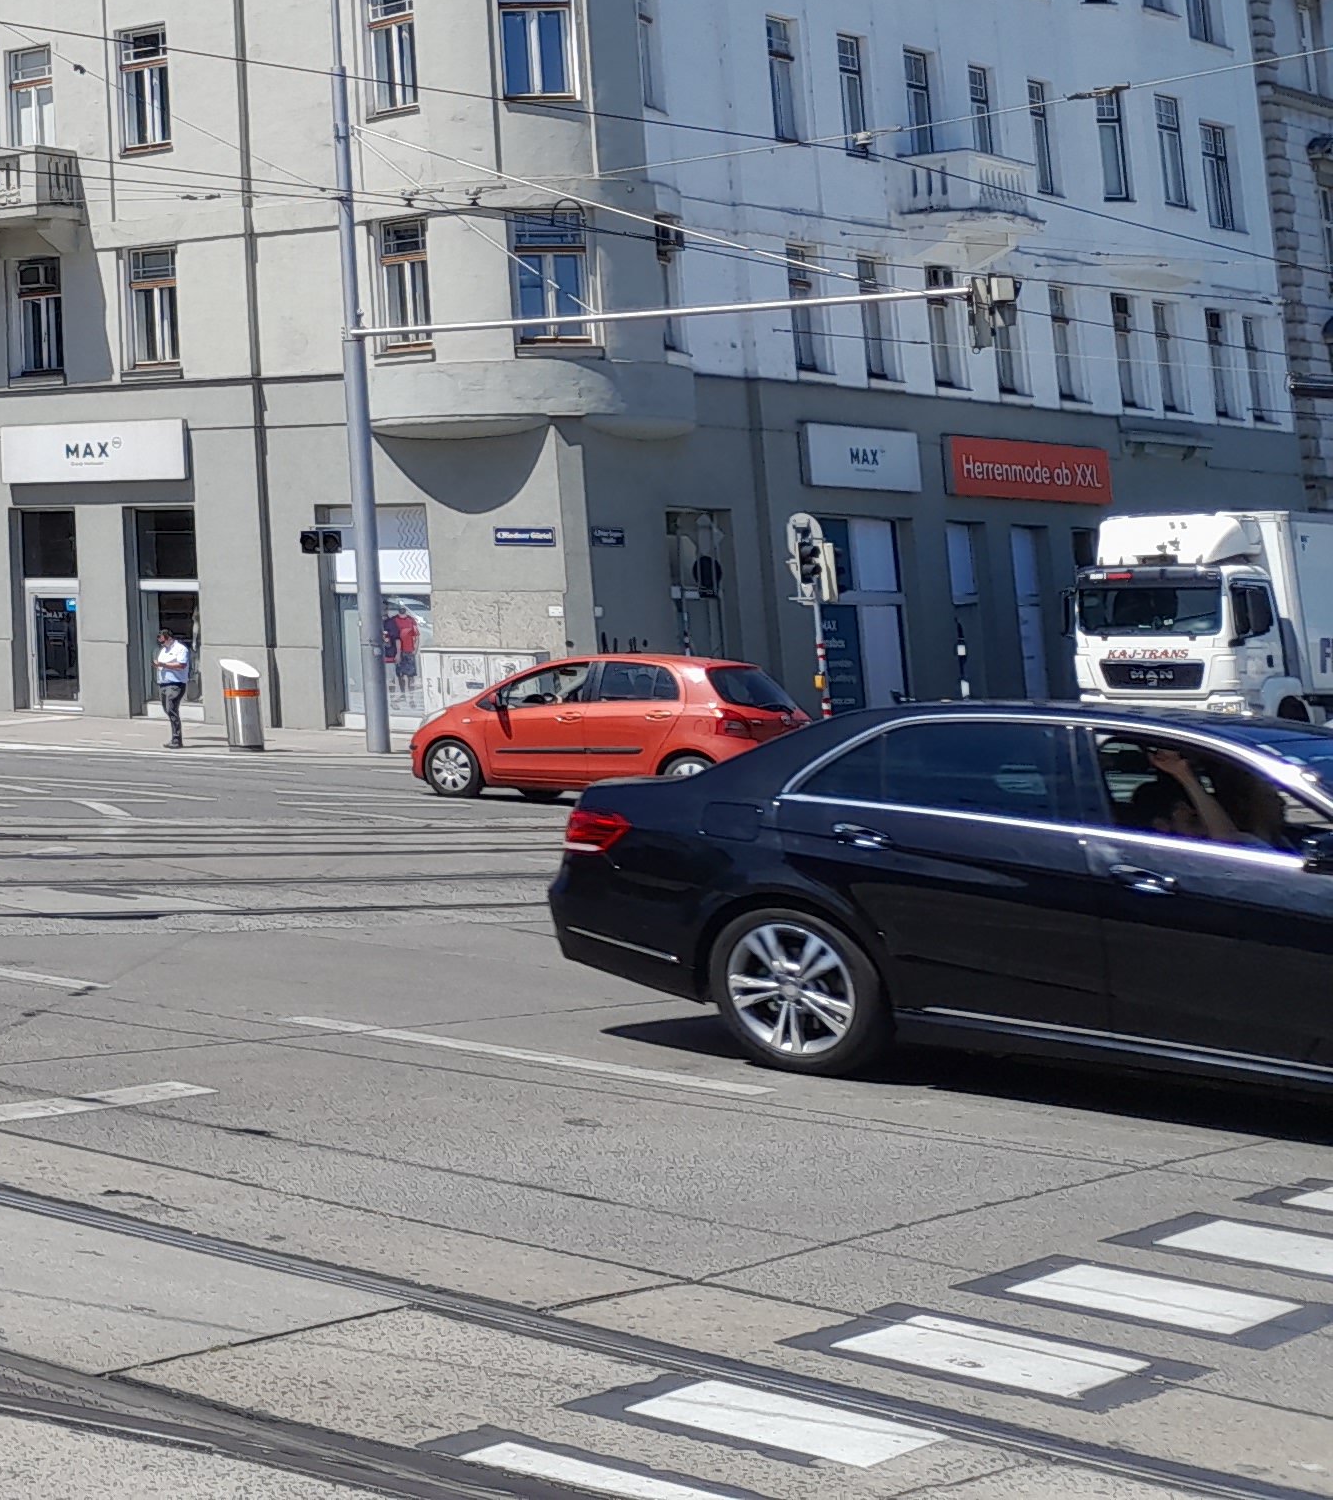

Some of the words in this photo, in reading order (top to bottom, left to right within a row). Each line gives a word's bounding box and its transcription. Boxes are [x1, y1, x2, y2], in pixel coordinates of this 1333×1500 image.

[64, 441, 110, 459] MAX
[849, 447, 879, 466] MAX
[961, 453, 1051, 485] Herrenmode
[1053, 461, 1072, 486] ab
[1074, 463, 1104, 488] XXL
[1107, 648, 1189, 660] KAJ-TRANS
[1130, 670, 1174, 680] MAN
